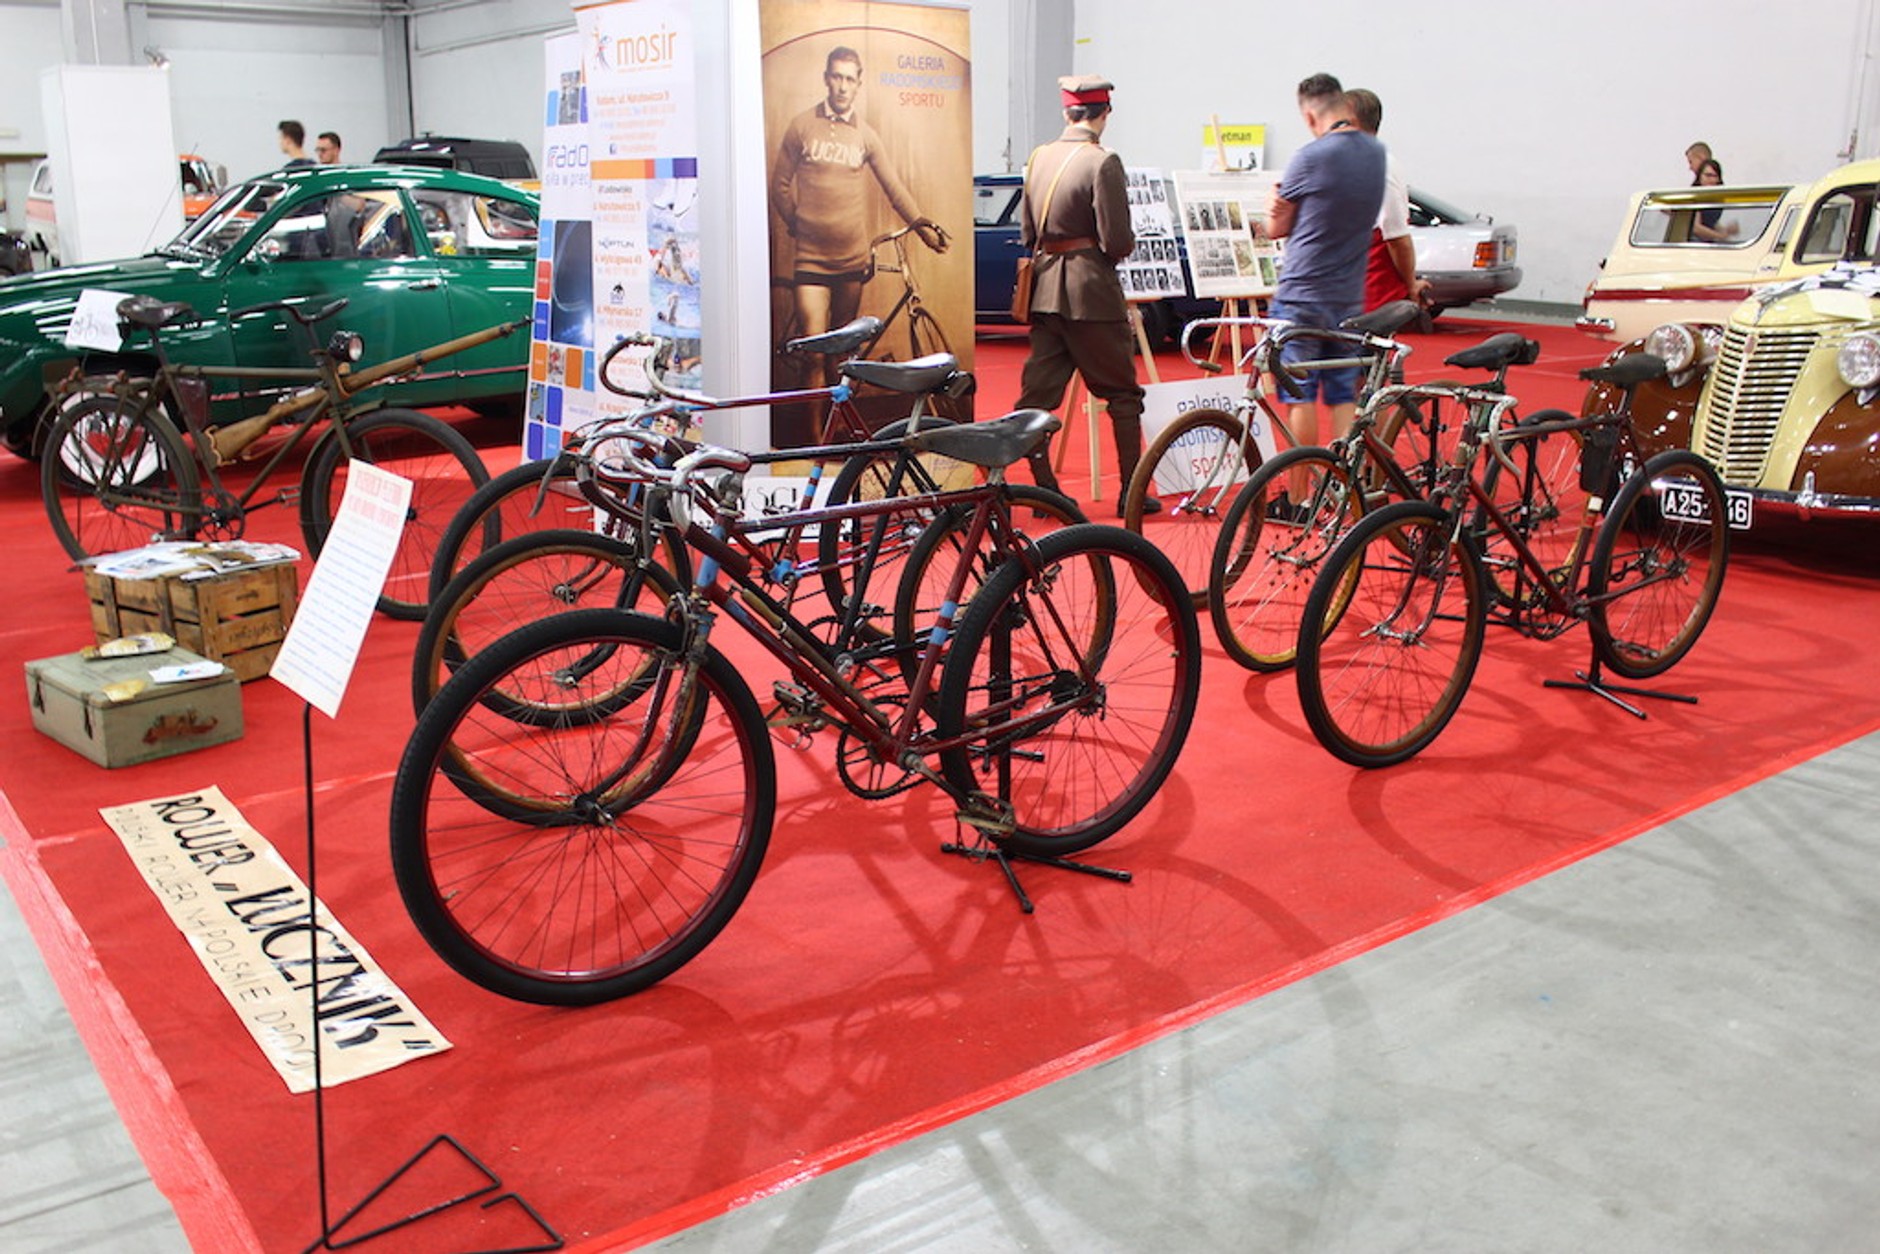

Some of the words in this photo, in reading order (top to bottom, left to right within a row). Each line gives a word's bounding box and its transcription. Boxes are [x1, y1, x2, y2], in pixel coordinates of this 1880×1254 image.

[616, 23, 677, 66] mosir
[898, 54, 945, 70] GALERIA
[899, 91, 945, 108] SPORTU
[1221, 131, 1252, 143] etman
[150, 795, 256, 876] ROWER
